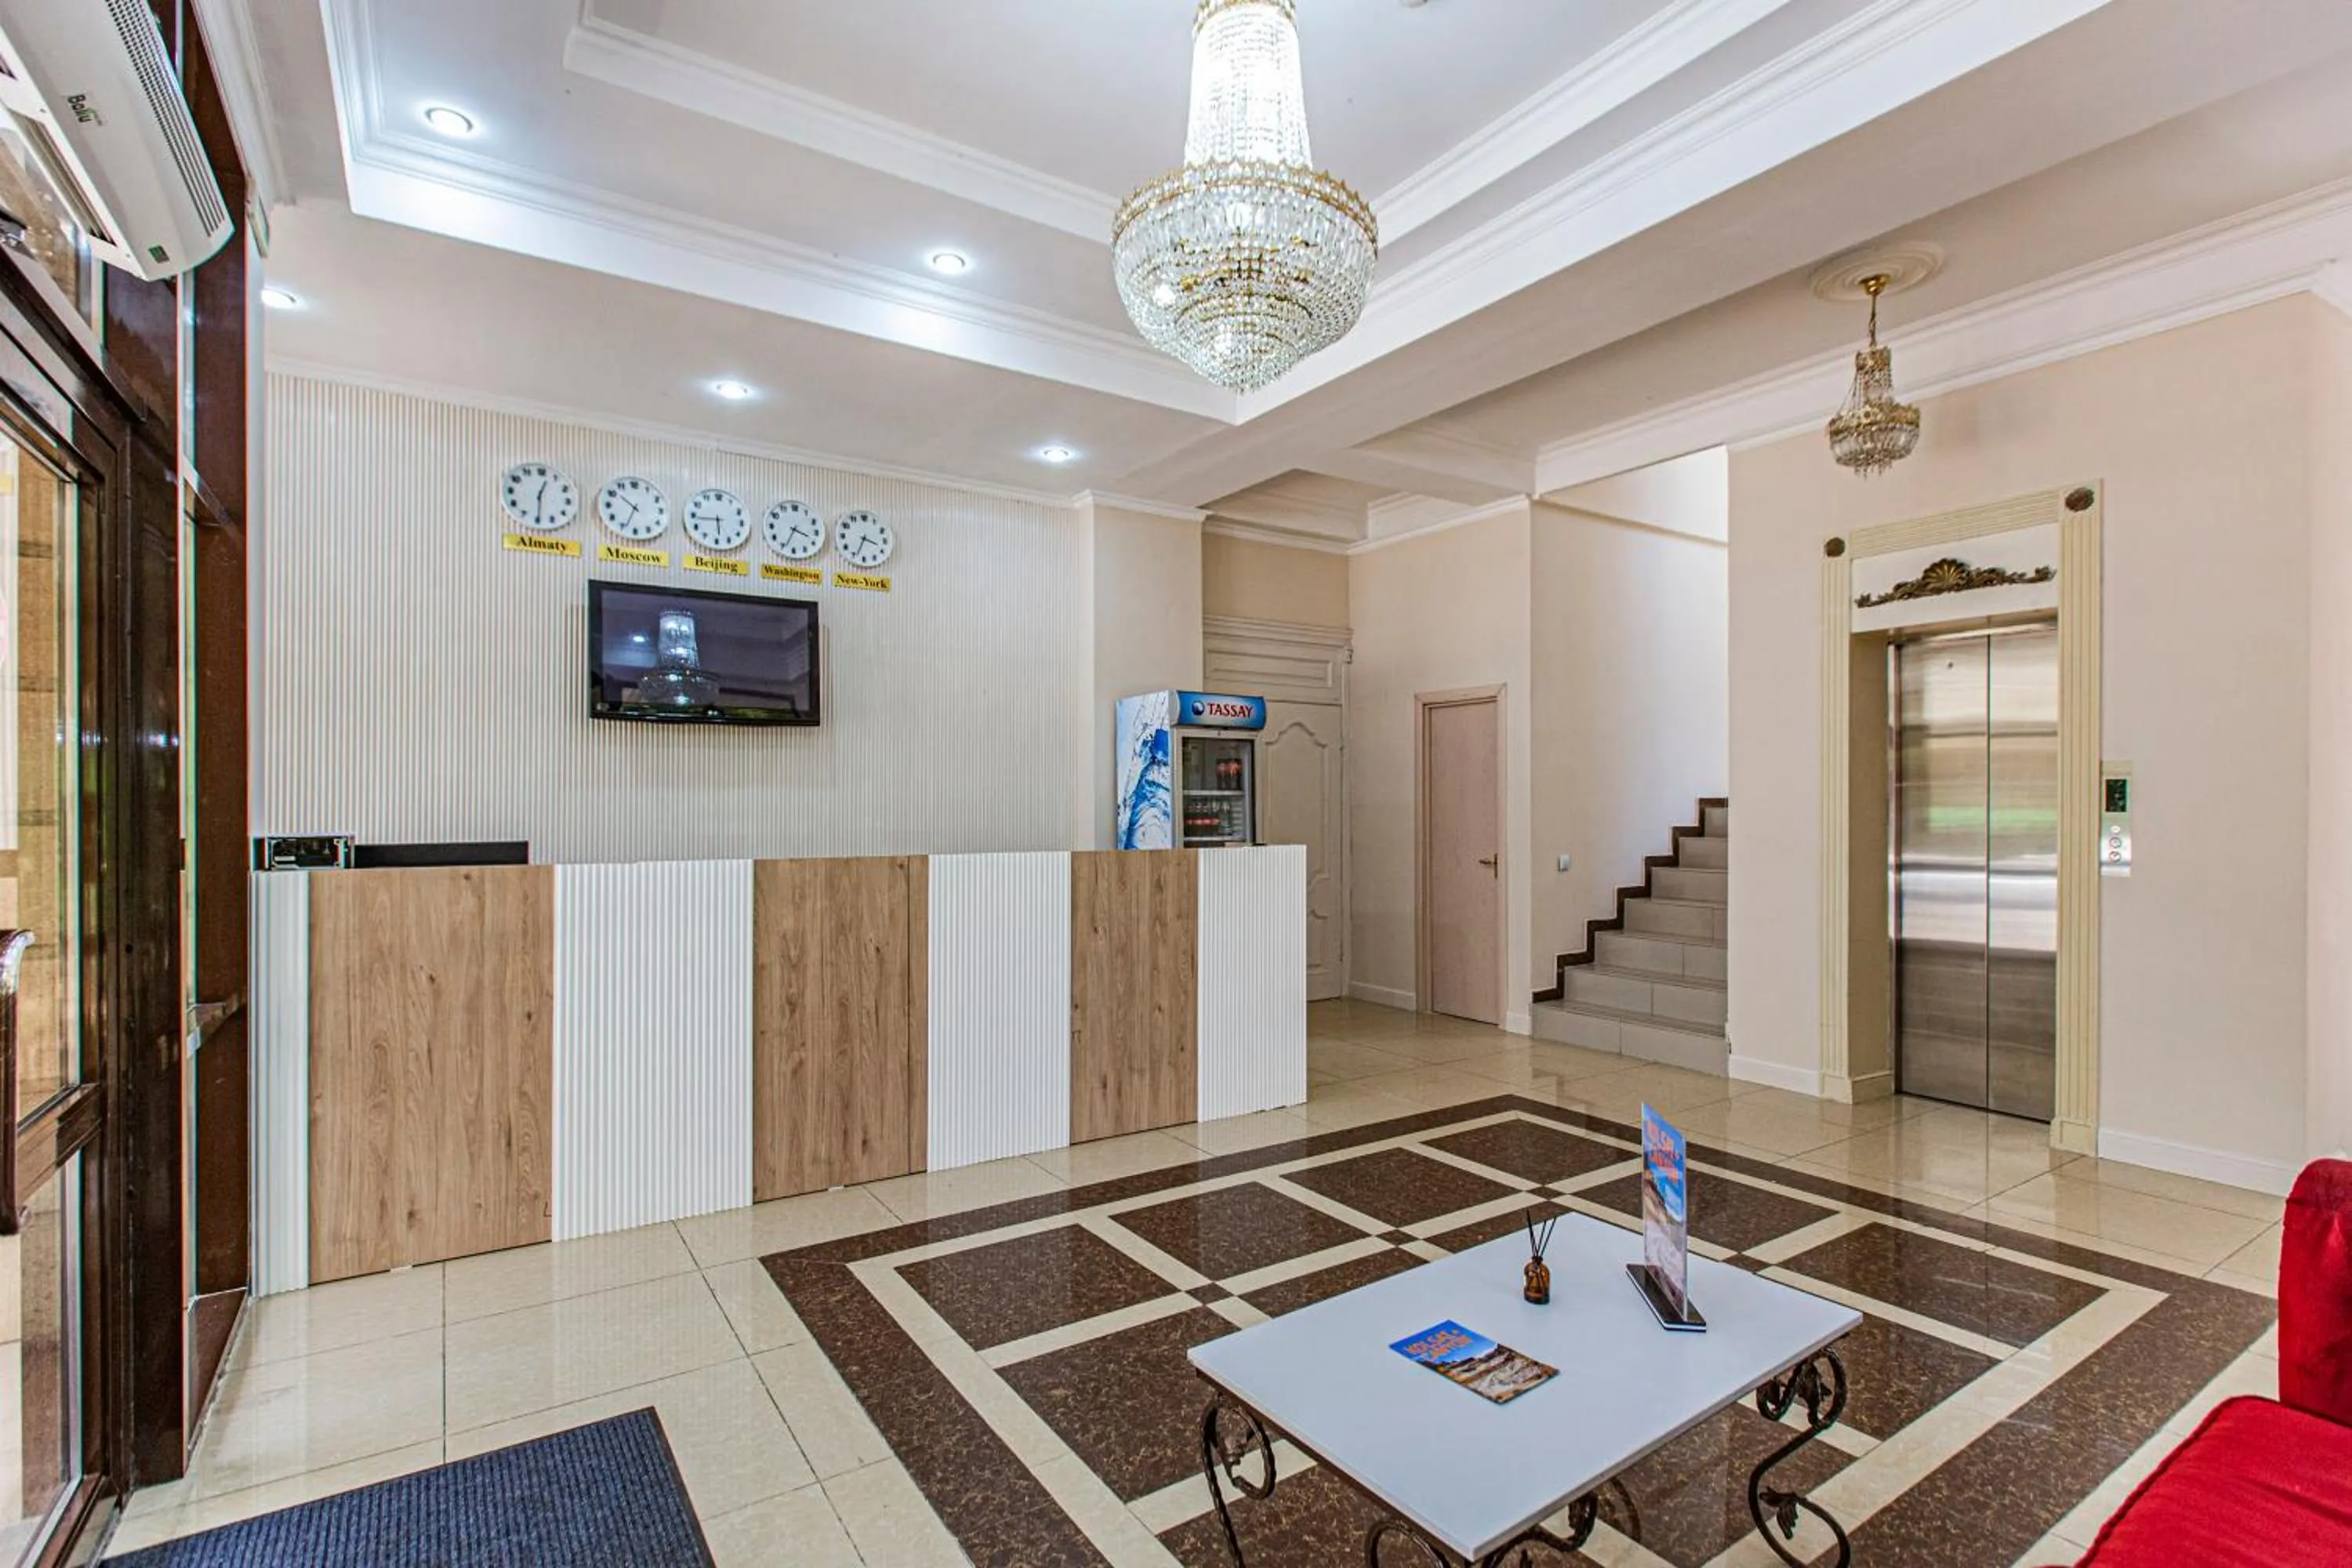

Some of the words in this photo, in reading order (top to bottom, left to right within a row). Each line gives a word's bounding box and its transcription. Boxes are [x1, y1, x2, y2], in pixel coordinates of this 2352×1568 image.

[518, 536, 567, 551] Almaty
[606, 547, 661, 563] Moscow
[695, 557, 739, 572] Beijing
[764, 564, 819, 580] Washington
[837, 573, 887, 589] New-York
[1207, 702, 1254, 718] TASSAY
